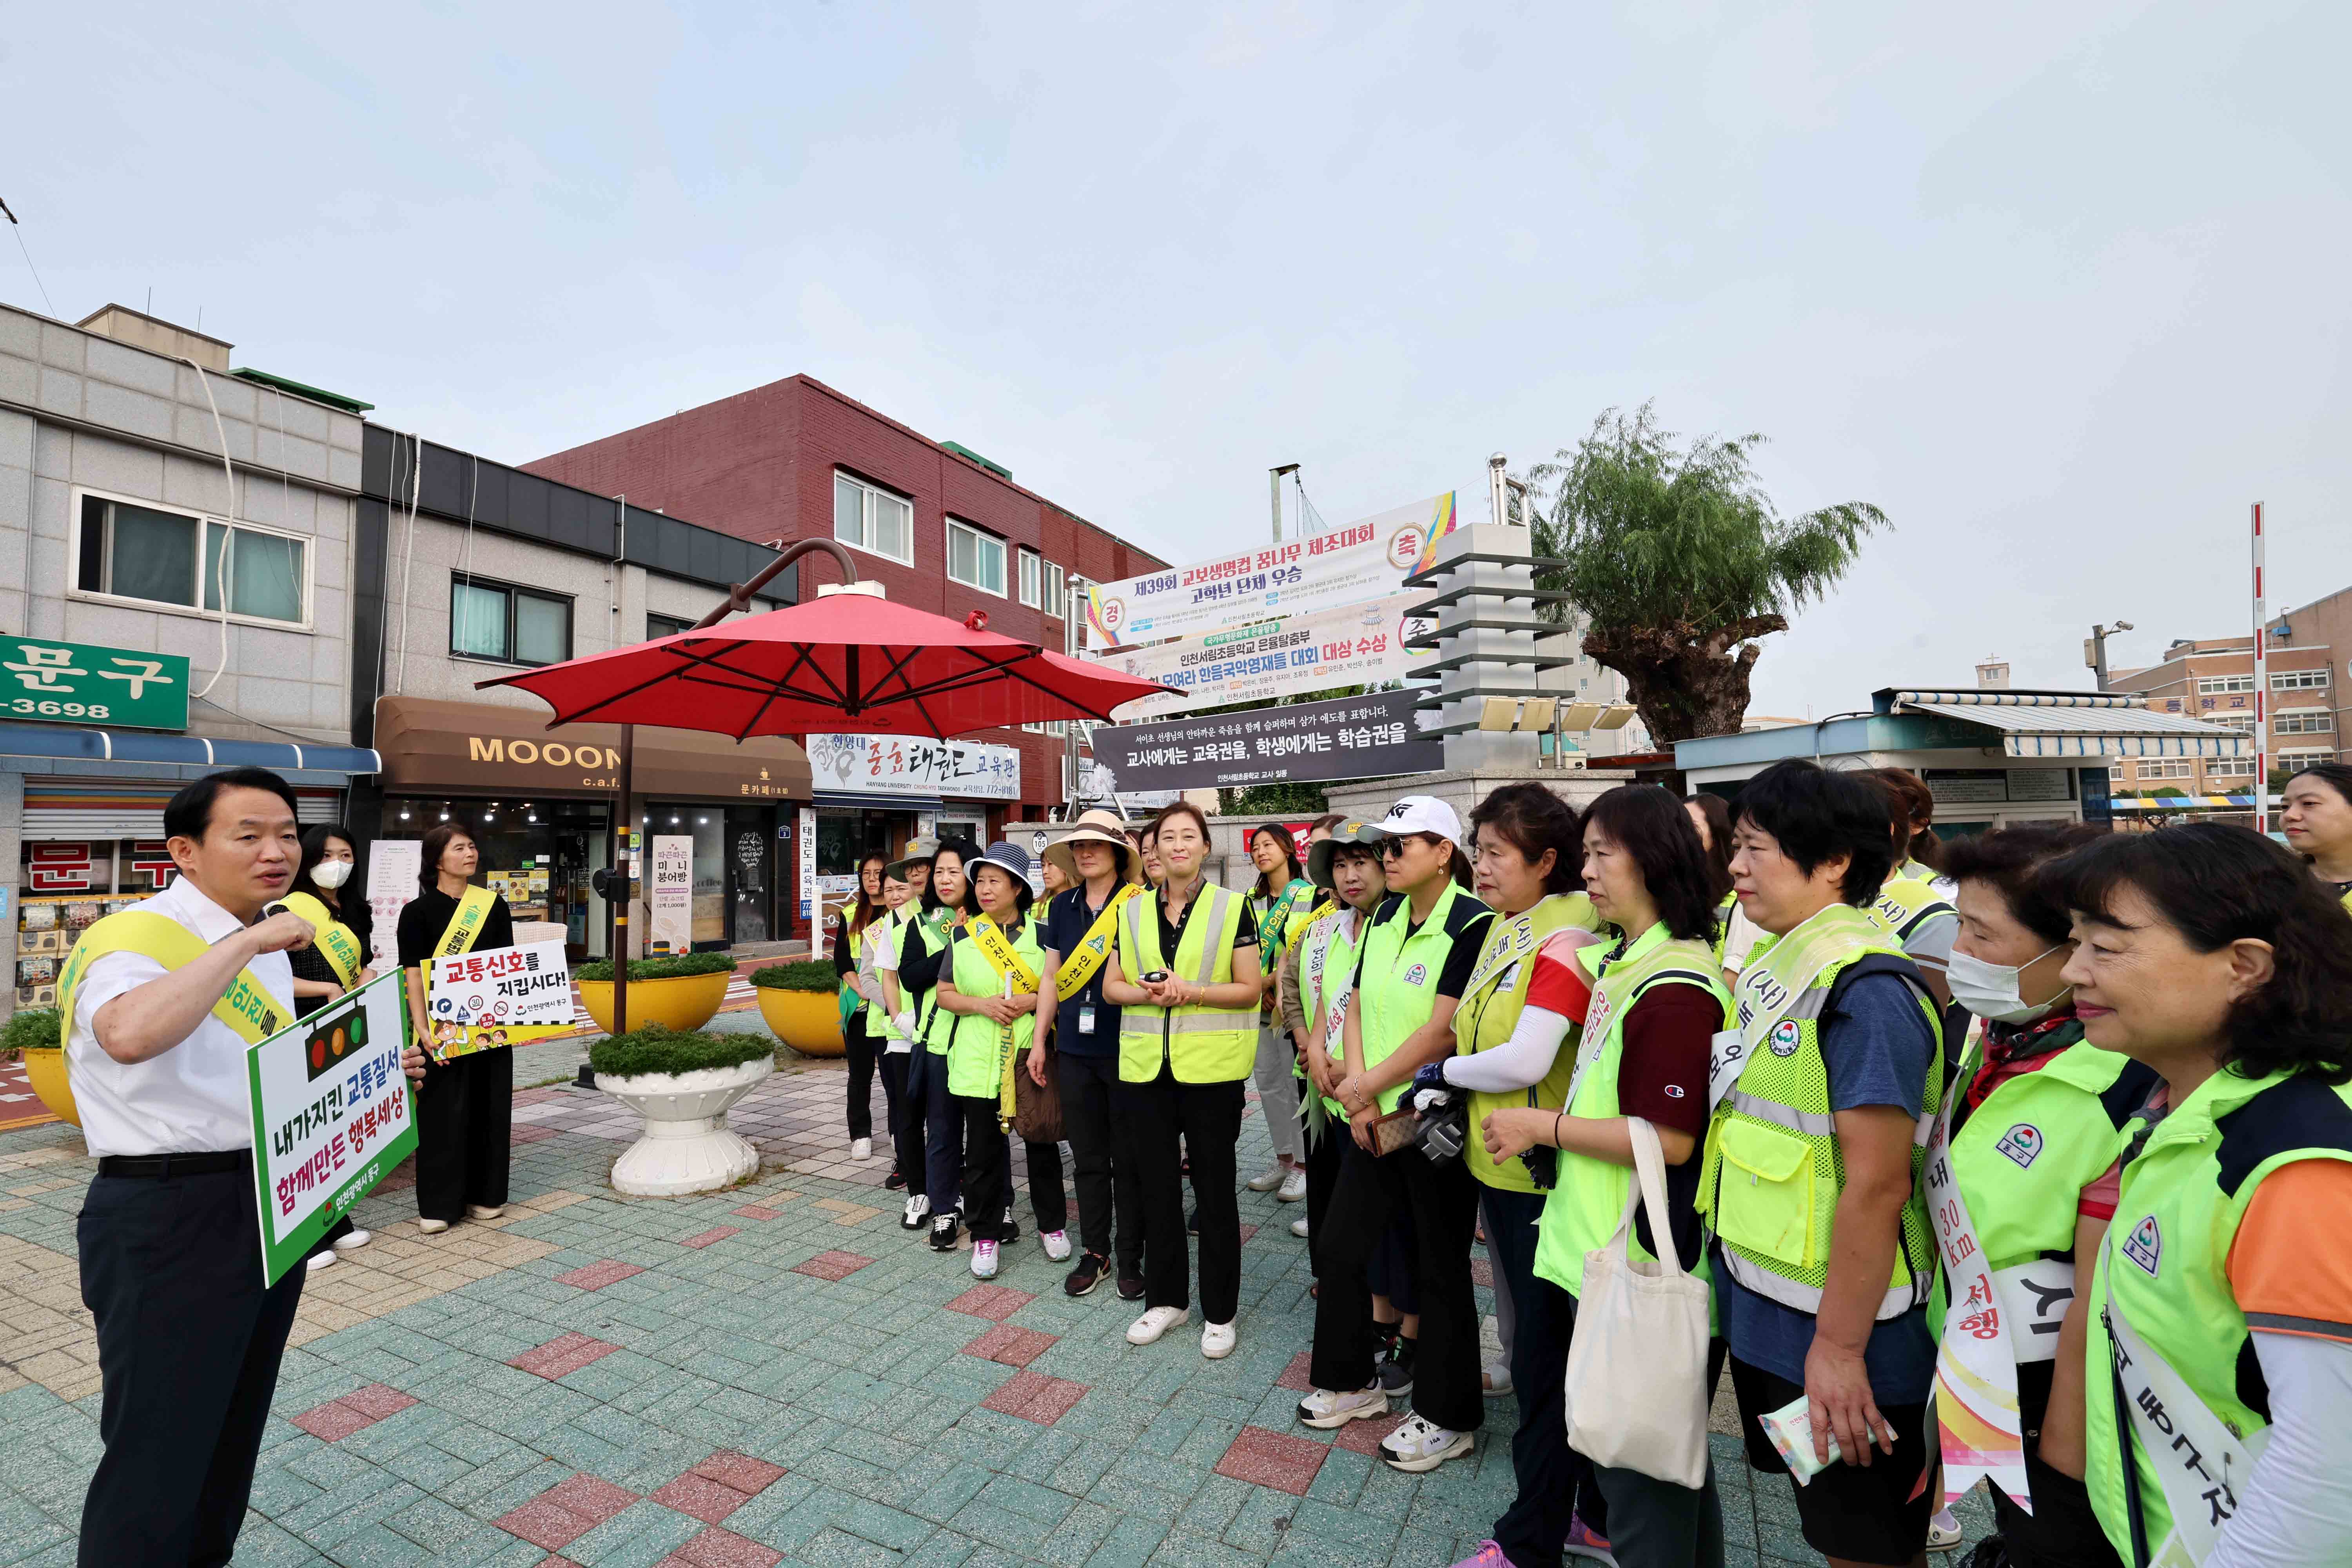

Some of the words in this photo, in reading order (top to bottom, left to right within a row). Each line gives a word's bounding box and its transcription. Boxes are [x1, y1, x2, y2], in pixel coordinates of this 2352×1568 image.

[1135, 573, 1177, 597] 제39회
[1182, 557, 1251, 586] 교보생명컵
[1257, 543, 1301, 570] 꿈나무
[1308, 523, 1374, 557] 체조대회
[1398, 534, 1416, 555] 축
[1191, 581, 1231, 604] 고학년
[1237, 573, 1266, 595] 단체
[1272, 565, 1302, 586] 우승
[1107, 605, 1118, 623] 경
[1229, 610, 1265, 622] 인천서림초등학교
[1181, 641, 1255, 666] 인천서림초등학교
[1258, 630, 1310, 651] 은율탈춤부
[1207, 631, 1249, 646] 국가무형문화재
[3, 645, 174, 699] 문구
[1163, 669, 1196, 688] 모여라
[1200, 652, 1287, 683] 한음국악영재들
[1291, 646, 1318, 667] 대회
[1323, 640, 1352, 661] 대상
[1357, 633, 1387, 655] 수상
[1227, 687, 1276, 702] 인천서림초등학교
[1135, 735, 1155, 745] 서이초
[1158, 730, 1184, 743] 선생님의
[1187, 727, 1216, 740] 안타까운
[1218, 723, 1242, 736] 죽음을
[1245, 721, 1261, 733] 함께
[1264, 717, 1296, 731] 슬퍼하며
[1299, 714, 1317, 727] 삼가
[1320, 710, 1347, 724] 애도를
[1350, 705, 1388, 720] 표합니다.
[469, 737, 621, 769] MOOON
[833, 734, 866, 750] 한양대
[1127, 746, 1188, 767] 교사에게는
[1192, 740, 1250, 762] 교육권을,
[1256, 732, 1332, 757] 학생에게는
[1338, 722, 1407, 749] 학습권을
[909, 744, 976, 782] 태권도
[976, 755, 1015, 779] 교육관
[1218, 772, 1259, 782] 인천서림초등학교
[1261, 771, 1274, 779] 교사
[1276, 769, 1288, 778] 일동
[741, 784, 769, 795] 문카페
[987, 784, 1016, 795] 772-8181
[803, 826, 813, 858] 태권도
[657, 871, 687, 883] 붕어빵
[803, 864, 813, 898] 교육관
[1514, 918, 1532, 949] (사)
[446, 951, 540, 984] 교통신호를
[497, 971, 566, 996] 지킵시다!
[527, 1001, 555, 1012] 인천광역시
[1746, 970, 1788, 1010] (사)
[274, 1083, 343, 1157] 내가지킨
[347, 1045, 399, 1107] 교통질서
[277, 1132, 345, 1217] 함께만든
[348, 1086, 403, 1154] 행복세상
[336, 1174, 367, 1212] 인천광역시
[368, 1163, 379, 1182] 동구
[1928, 1156, 1949, 1189] 내
[1940, 1199, 1959, 1237] 30
[1945, 1231, 1976, 1269] km
[1958, 1273, 1999, 1340] 서행
